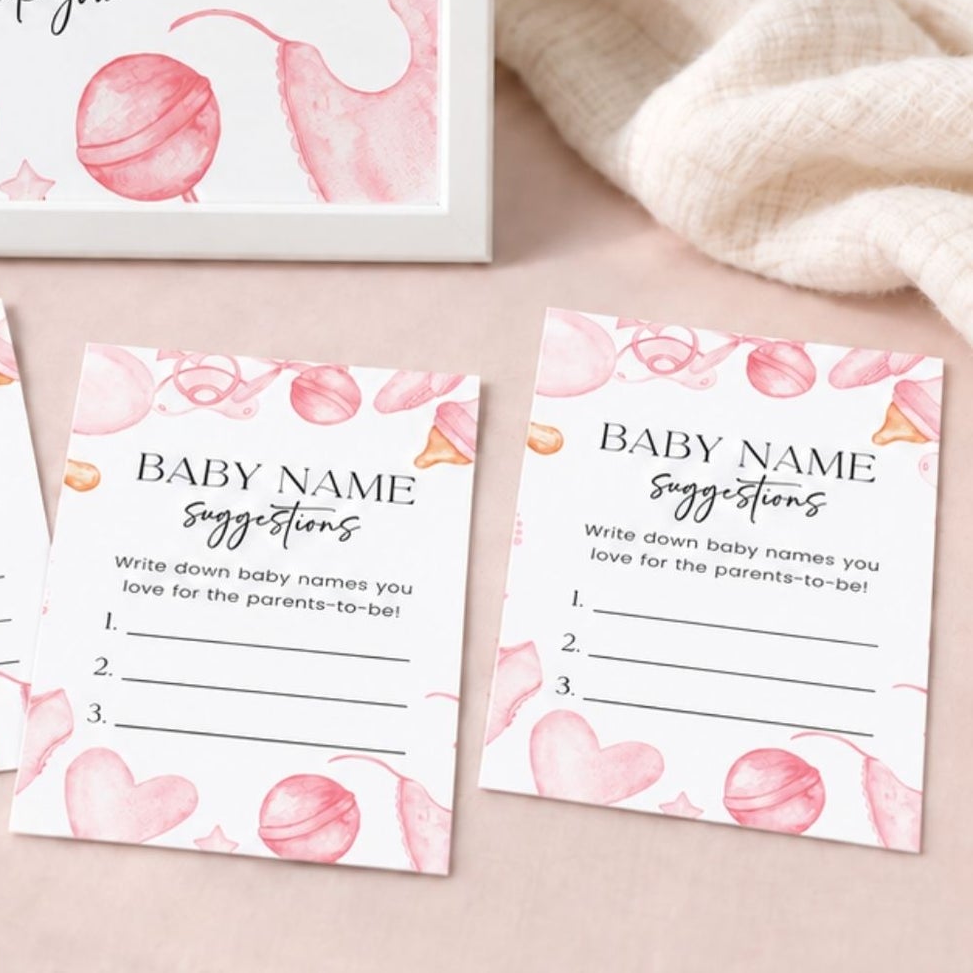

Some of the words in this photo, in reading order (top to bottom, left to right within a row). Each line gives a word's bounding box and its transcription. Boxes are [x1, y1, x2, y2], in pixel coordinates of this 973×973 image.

[599, 422, 724, 464] BABY
[738, 439, 876, 484] NAME
[136, 452, 262, 491] BABY
[278, 465, 416, 506] NAME
[649, 472, 827, 525] suggestions
[182, 500, 361, 551] suggestions
[584, 523, 636, 542] Write
[643, 531, 698, 549] down
[706, 538, 759, 560] baby
[765, 548, 835, 566] names
[843, 557, 880, 572] you
[115, 555, 167, 573] Write
[174, 562, 230, 579] down
[238, 567, 291, 587] baby
[298, 575, 368, 591] names
[376, 582, 413, 596] you
[590, 547, 633, 565] love
[640, 553, 668, 569] for
[675, 558, 707, 574] the
[715, 563, 868, 593] parents-to-be!
[122, 579, 165, 597] love
[172, 584, 200, 599] for
[207, 588, 240, 603] the
[246, 594, 400, 618] parents-to-be!
[571, 589, 583, 608] 1.
[105, 611, 117, 631] 1.
[560, 632, 580, 653] 2.
[93, 656, 113, 677] 2.
[555, 676, 575, 696] 3.
[86, 703, 107, 724] 3.
